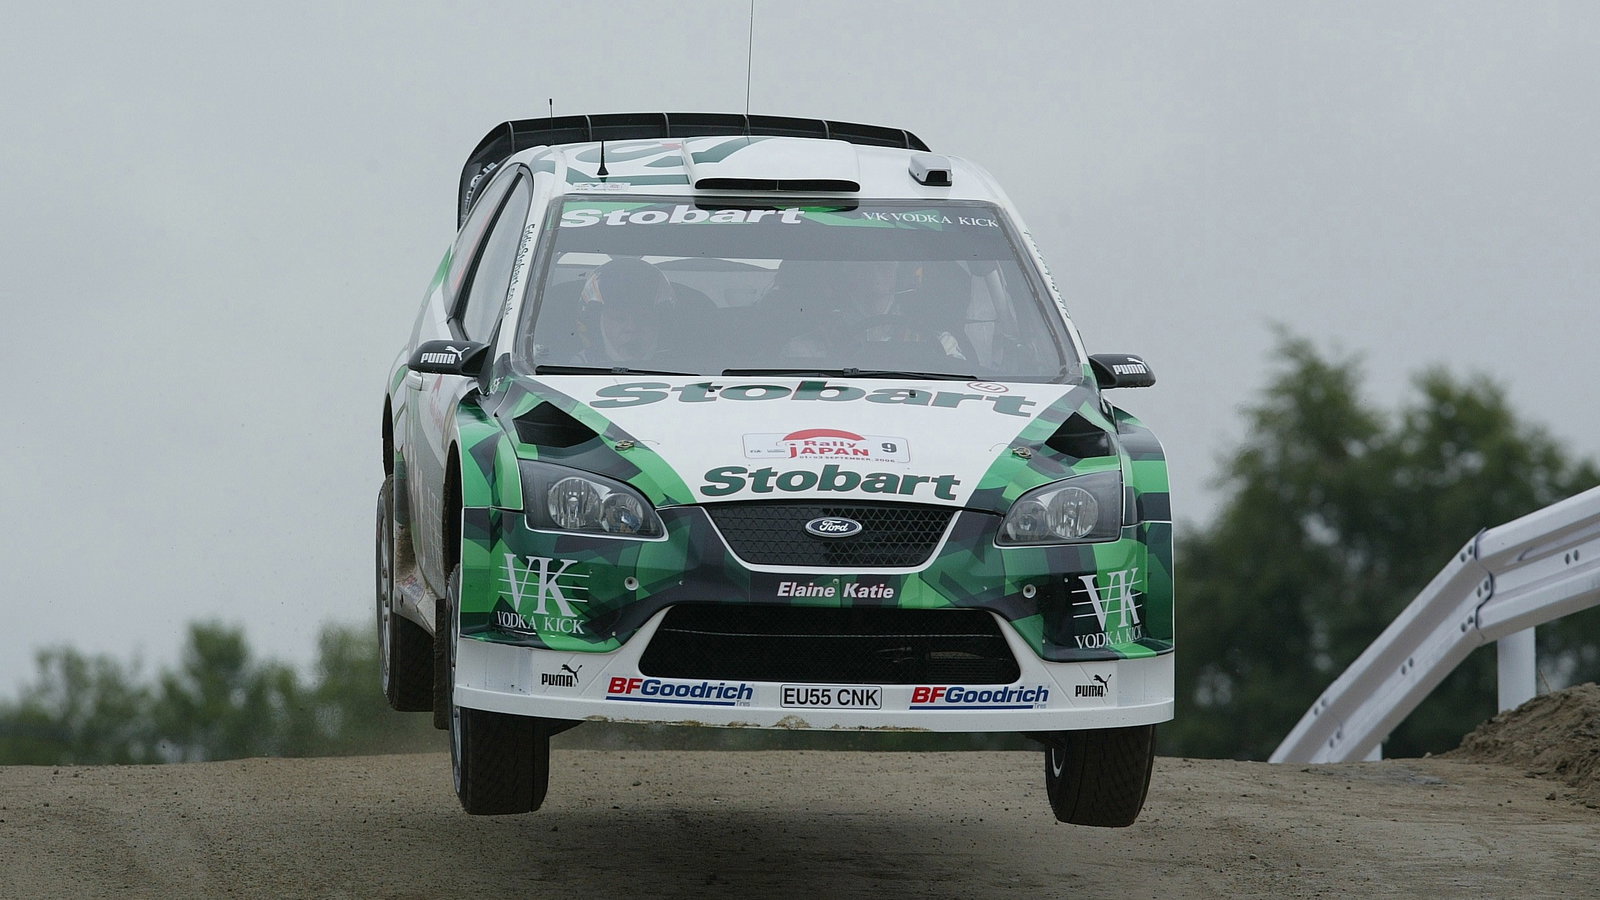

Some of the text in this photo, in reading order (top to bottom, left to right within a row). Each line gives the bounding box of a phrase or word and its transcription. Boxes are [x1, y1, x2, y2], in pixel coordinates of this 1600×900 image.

[560, 204, 805, 228] Stobart
[862, 211, 1000, 228] VK VODKA KICK
[420, 352, 457, 364] PUMA
[1112, 364, 1147, 375] PUMA
[589, 380, 1037, 418] Stobart
[803, 439, 858, 449] Rally
[881, 442, 898, 454] 9
[699, 463, 962, 501] Stobart
[819, 519, 849, 532] Ford
[503, 553, 579, 618] VK
[777, 581, 895, 599] Elaine Katie
[1078, 567, 1140, 632] VK
[496, 610, 585, 635] VODKA KICK
[1073, 630, 1122, 650] VODKA
[541, 673, 574, 687] PUMA
[607, 676, 754, 700] BFGoodrich
[783, 687, 879, 706] EU55 CNK
[910, 685, 1050, 703] BFGoodrich
[1075, 684, 1104, 698] PUMA
